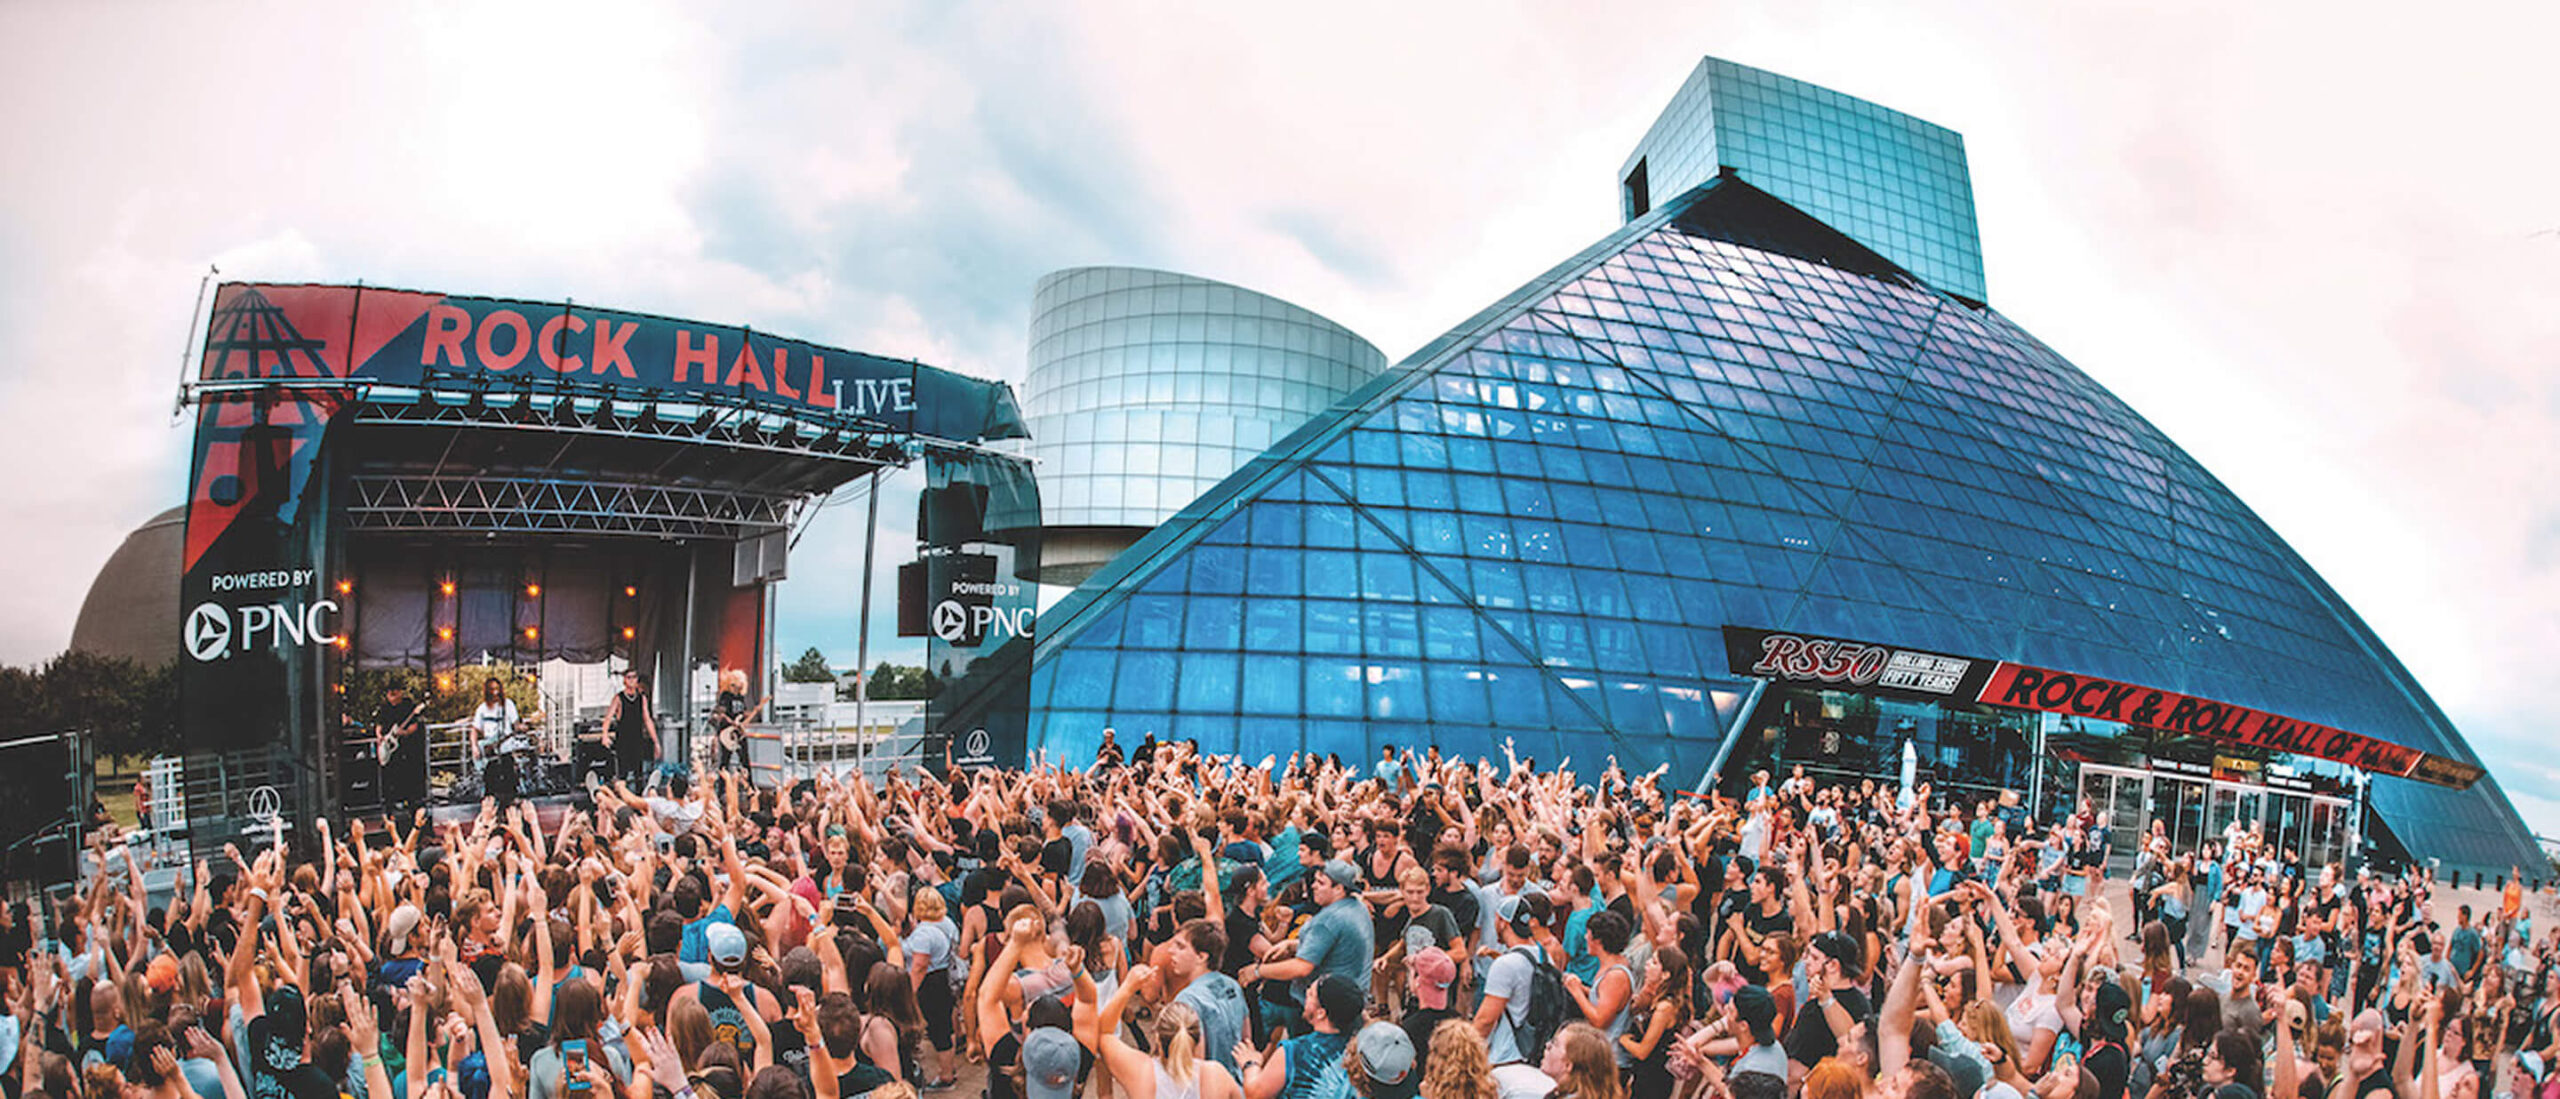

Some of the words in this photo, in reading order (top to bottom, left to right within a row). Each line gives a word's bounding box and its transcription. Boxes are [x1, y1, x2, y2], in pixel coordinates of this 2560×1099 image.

[421, 304, 640, 379] ROCK
[673, 329, 836, 409] HALL
[832, 378, 918, 415] LIVE
[211, 570, 290, 592] POWERED
[293, 569, 314, 587] BY
[951, 581, 1006, 597] POWERED
[1008, 584, 1021, 597] BY
[238, 599, 338, 651] PNC
[971, 606, 1035, 639] PNC
[1753, 635, 1889, 686] RS50
[1884, 669, 1921, 686] FIFTY
[1918, 673, 1957, 691] YEARS
[2003, 668, 2137, 719] ROCK
[2131, 691, 2163, 725] &
[2163, 697, 2251, 740] ROLL
[2251, 715, 2325, 754] HALL
[2323, 733, 2361, 759] OF
